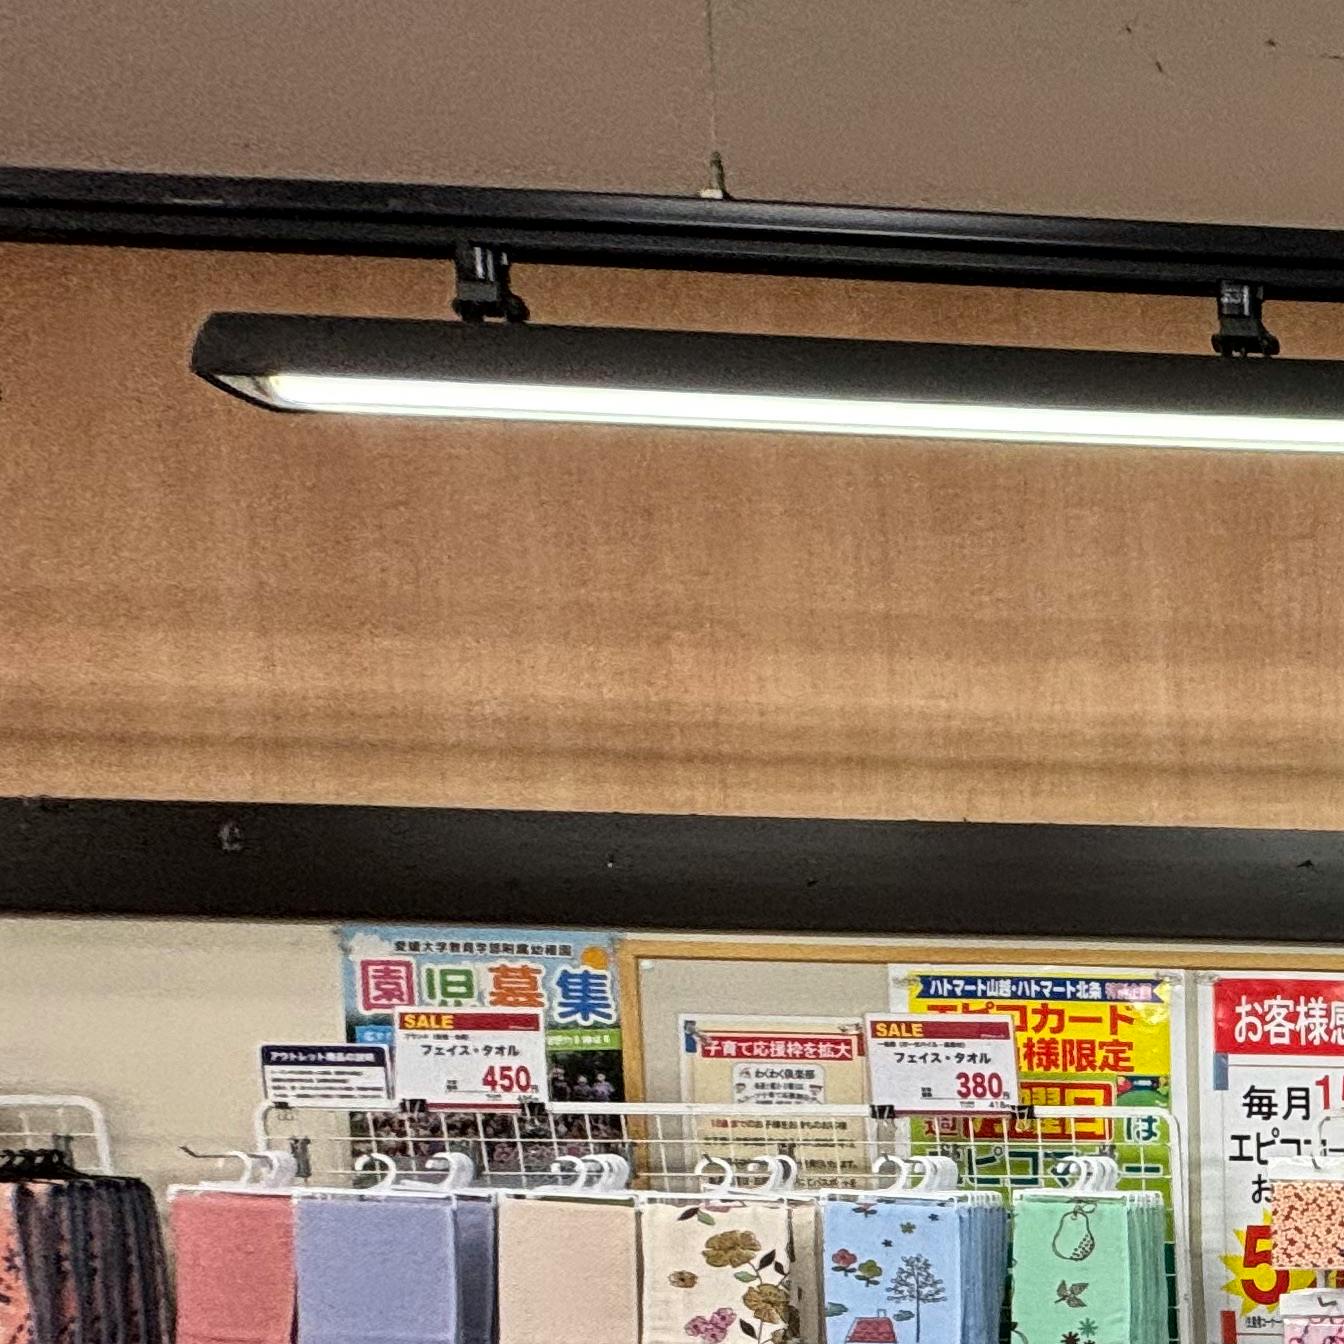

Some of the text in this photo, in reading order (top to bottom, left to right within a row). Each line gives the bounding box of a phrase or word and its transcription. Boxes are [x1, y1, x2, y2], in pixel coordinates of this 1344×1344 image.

[403, 1013, 454, 1029] SALE
[875, 1023, 923, 1038] SALE
[420, 1044, 521, 1057] フェイス・タオル
[704, 1040, 851, 1059] 子育て応援枠を拡大
[894, 1052, 991, 1065] フェイス・タオル
